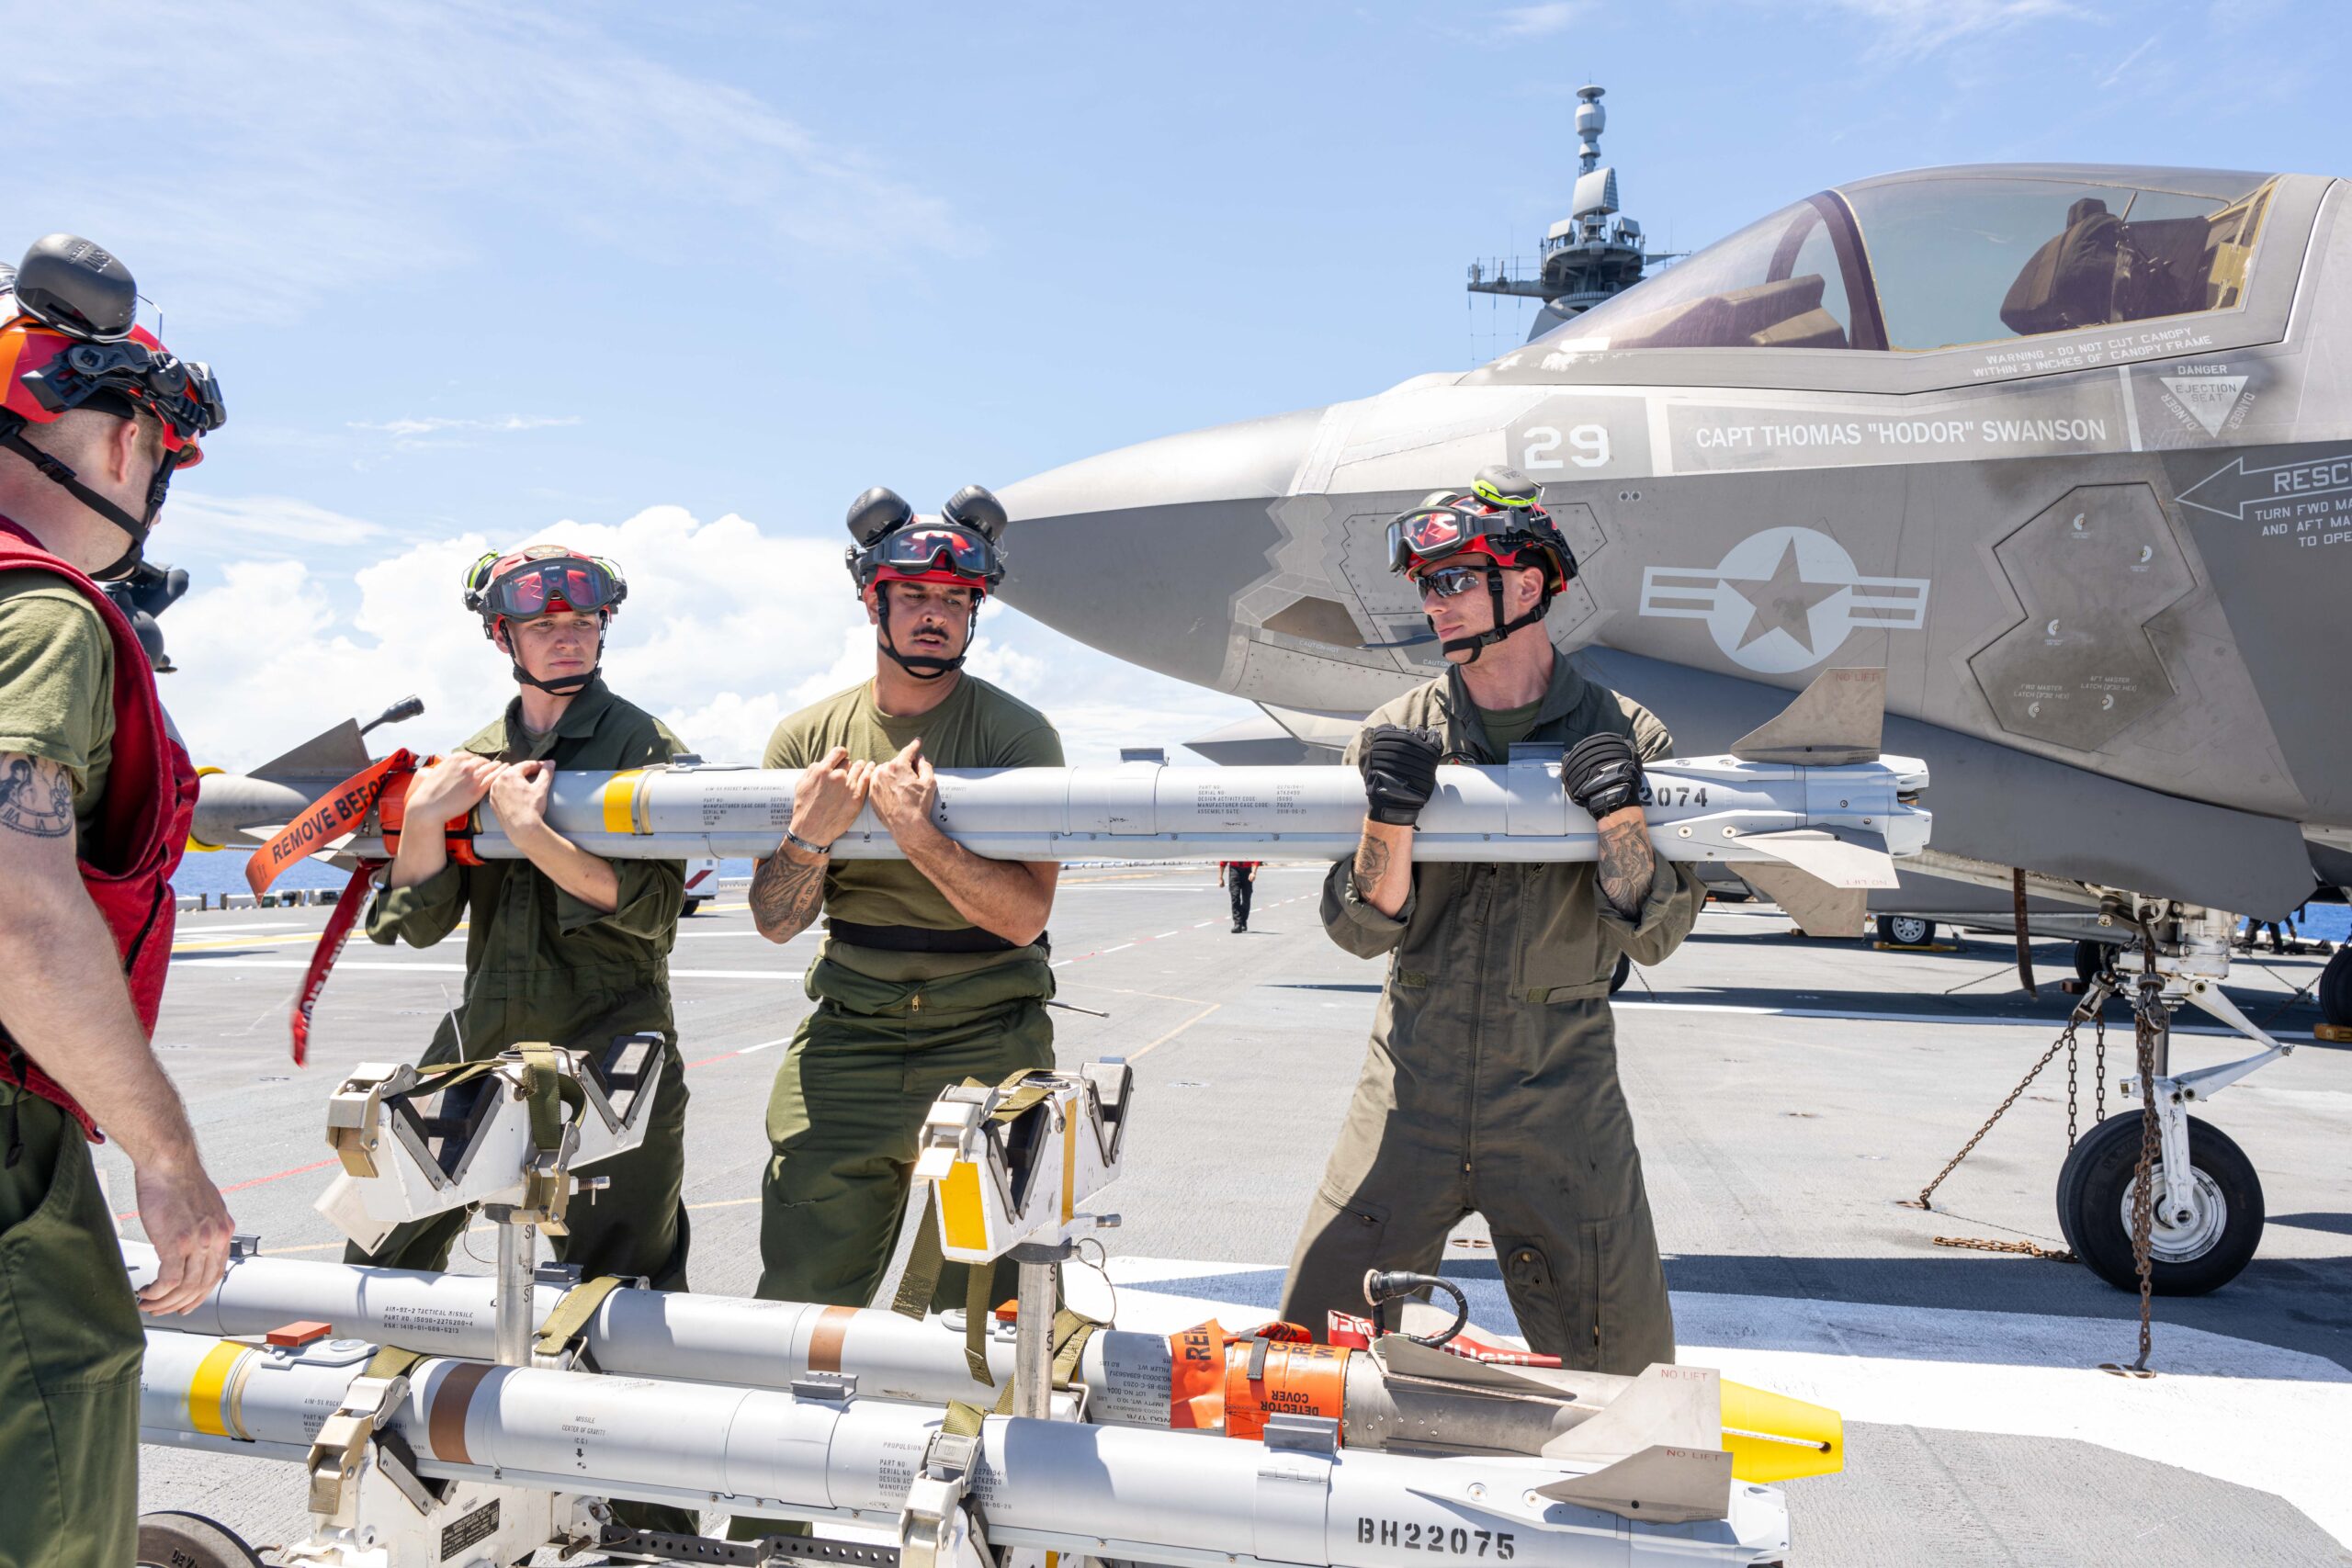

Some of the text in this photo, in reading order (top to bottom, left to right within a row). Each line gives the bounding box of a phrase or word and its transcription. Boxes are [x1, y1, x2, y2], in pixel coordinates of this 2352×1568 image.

[1985, 350, 2044, 366] WARNING
[2058, 345, 2075, 356] DO
[2078, 342, 2102, 354] NOT
[2109, 336, 2134, 349] CUT
[2140, 327, 2192, 344] CANOPY
[1973, 335, 2213, 378] WITHIN 3 INCHES OF CANOPY FRAME
[2177, 365, 2228, 376] DANGER
[2176, 383, 2237, 394] EJECTION
[2190, 392, 2223, 402] SEAT
[2160, 393, 2198, 432] DANGER
[2226, 391, 2256, 430] DANGER
[1696, 419, 2107, 448] CAPT THOMAS "HODOR" SWANSON
[1523, 423, 1610, 470] 29
[2274, 462, 2352, 493] RESC
[2255, 506, 2290, 521] TURN
[2297, 502, 2329, 516] FWD
[2262, 523, 2288, 536] AND
[2297, 518, 2324, 532] AFT
[2299, 531, 2352, 547] TO OPE
[1836, 672, 1879, 682] NO LIFT
[2080, 682, 2102, 691] LATCH
[272, 807, 336, 865] REMOVE
[417, 1308, 447, 1317] TACTICAL
[1661, 1369, 1707, 1382] NO LIFT
[1272, 1390, 1309, 1404] COVER
[1260, 1401, 1319, 1416] DETECTOR
[575, 1416, 596, 1424] MISSILE
[561, 1425, 580, 1433] CENTER
[879, 1459, 895, 1467] PART
[1667, 1449, 1721, 1462] NO LIFT
[1358, 1517, 1515, 1560] BH22075
